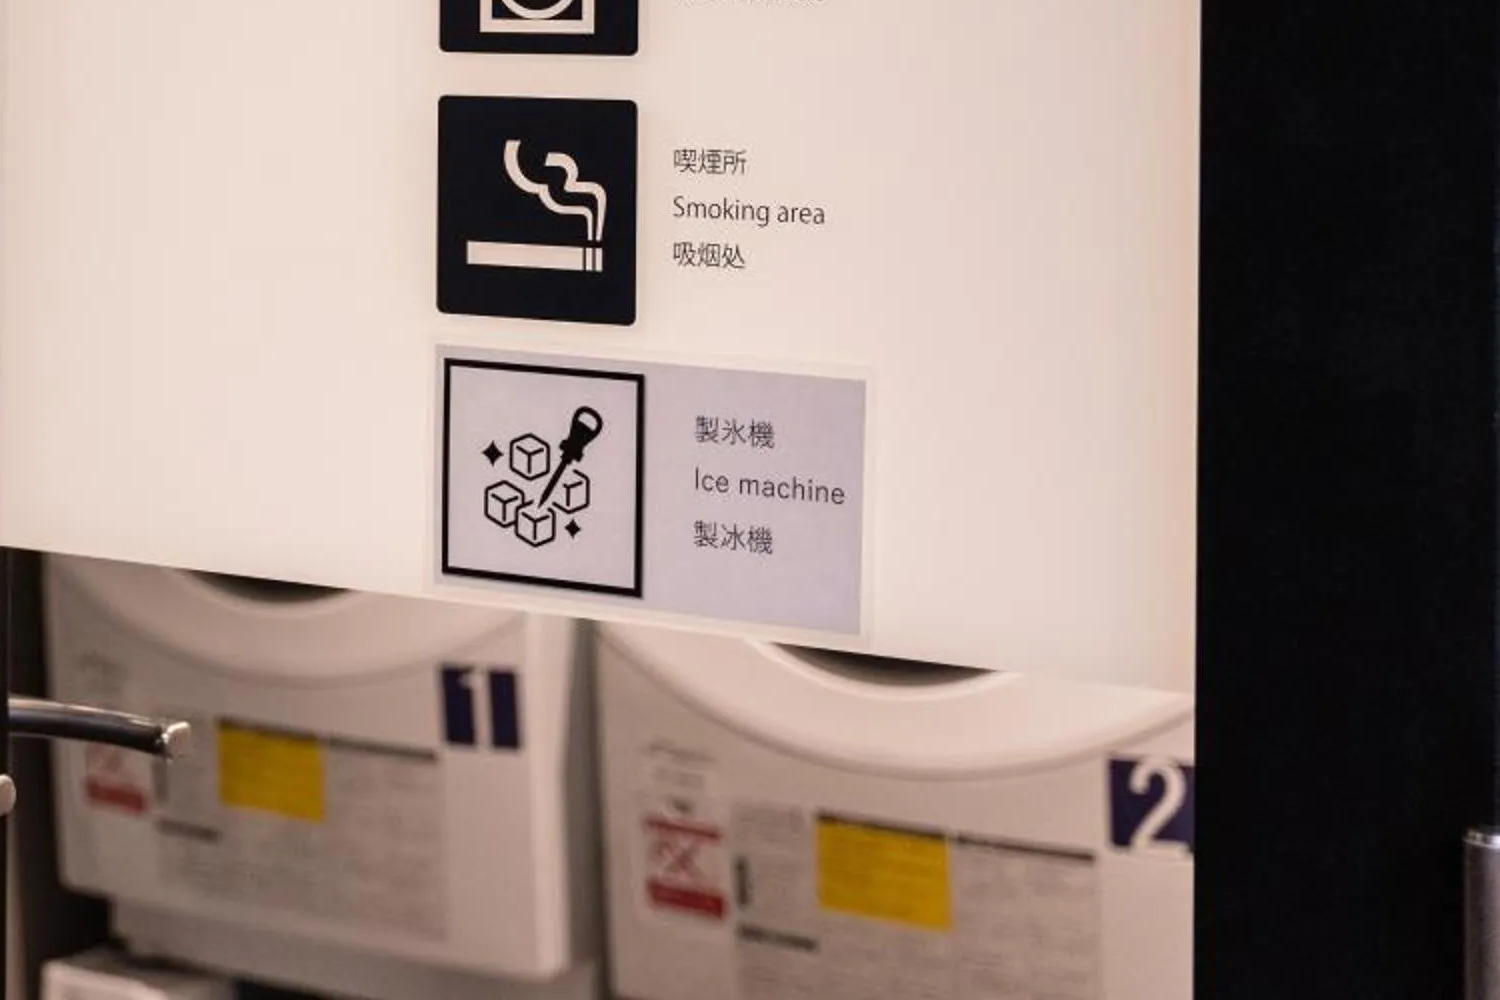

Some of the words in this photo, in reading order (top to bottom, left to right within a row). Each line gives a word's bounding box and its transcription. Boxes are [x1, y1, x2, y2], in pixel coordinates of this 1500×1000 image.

[673, 148, 748, 175] 喫煙所
[672, 195, 770, 228] Smoking
[776, 204, 826, 225] area
[672, 241, 746, 269] 吸烟处
[694, 415, 775, 449] 製氷機
[694, 466, 730, 494] Ice
[738, 475, 846, 505] machine
[693, 519, 774, 555] 製冰機
[458, 666, 491, 750] 1
[1129, 756, 1190, 854] 2
